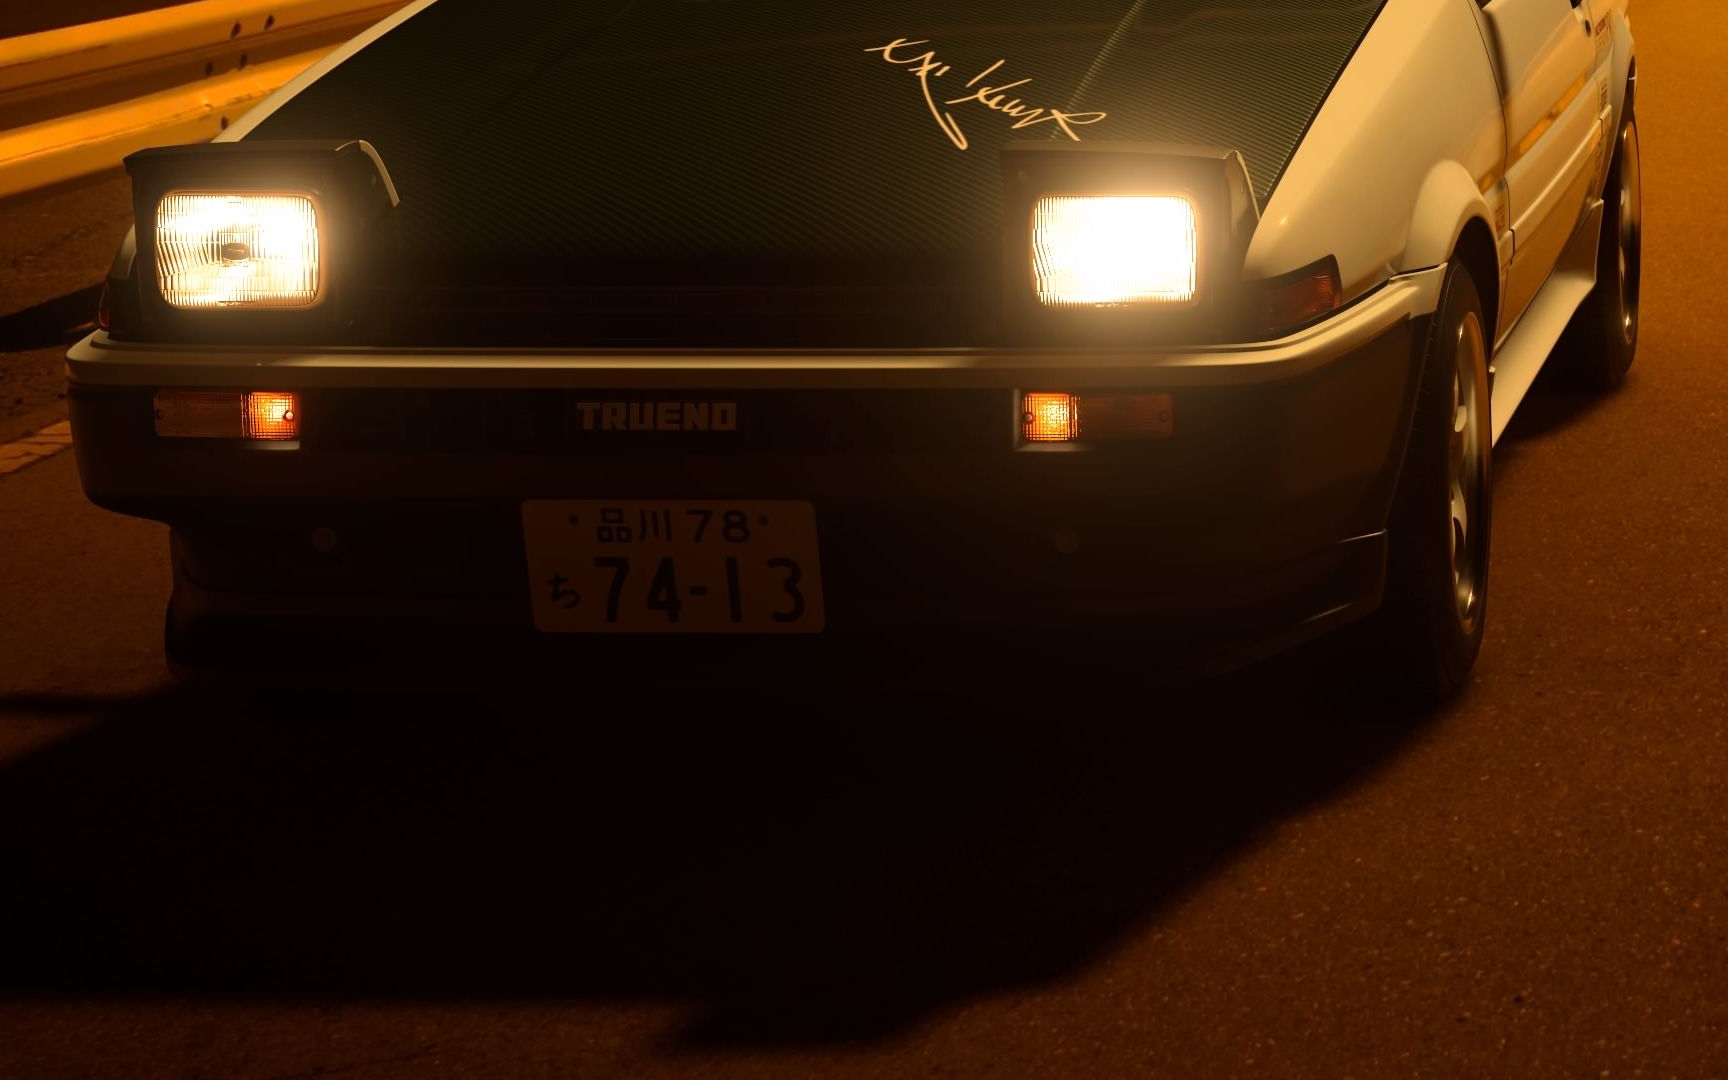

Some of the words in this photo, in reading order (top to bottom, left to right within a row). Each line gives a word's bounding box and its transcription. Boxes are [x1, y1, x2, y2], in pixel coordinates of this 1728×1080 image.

[576, 402, 737, 431] TRUENO
[597, 507, 672, 543] 品川
[686, 509, 750, 543] 78
[549, 572, 580, 609] ち
[593, 557, 804, 622] 74-13
